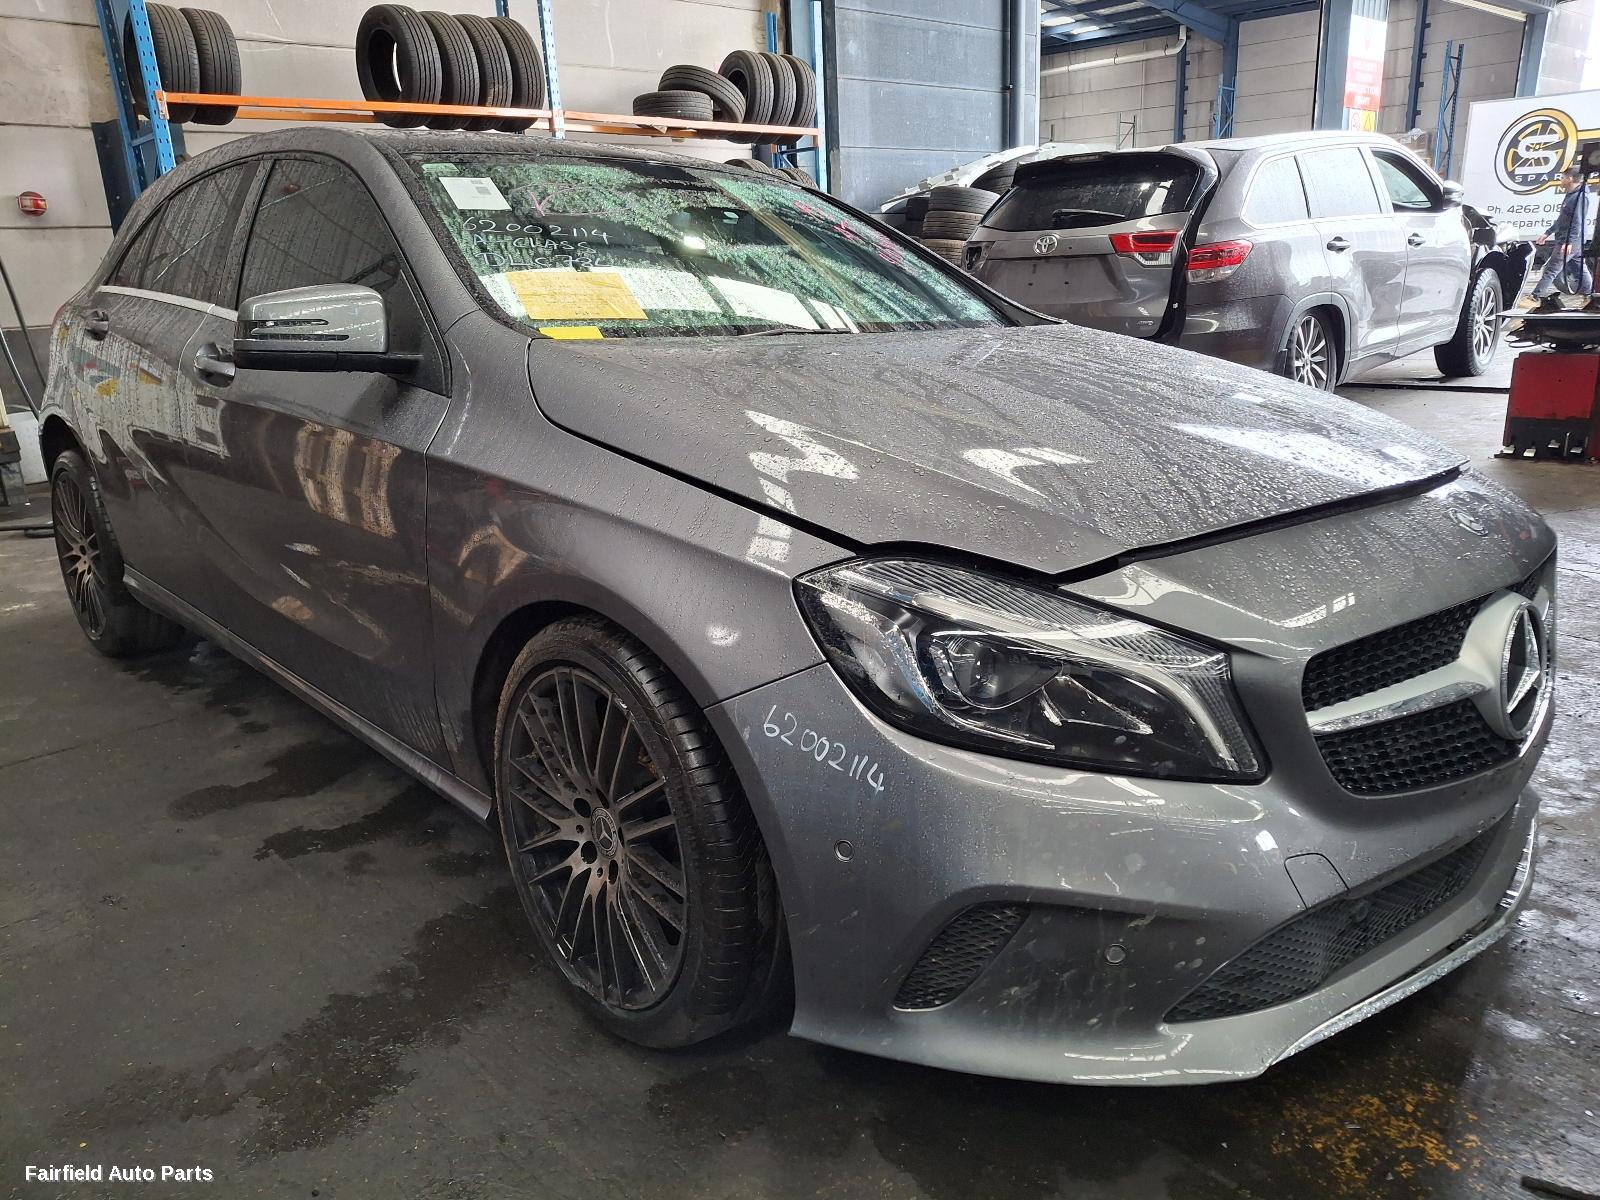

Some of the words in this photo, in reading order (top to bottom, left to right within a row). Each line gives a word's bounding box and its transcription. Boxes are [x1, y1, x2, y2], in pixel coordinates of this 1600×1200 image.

[1514, 173, 1562, 183] SPAR
[1487, 205, 1503, 214] Ph.
[1507, 204, 1540, 214] 4262
[1543, 203, 1562, 213] 018
[463, 216, 615, 245] 62002114
[763, 704, 885, 797] 62002114
